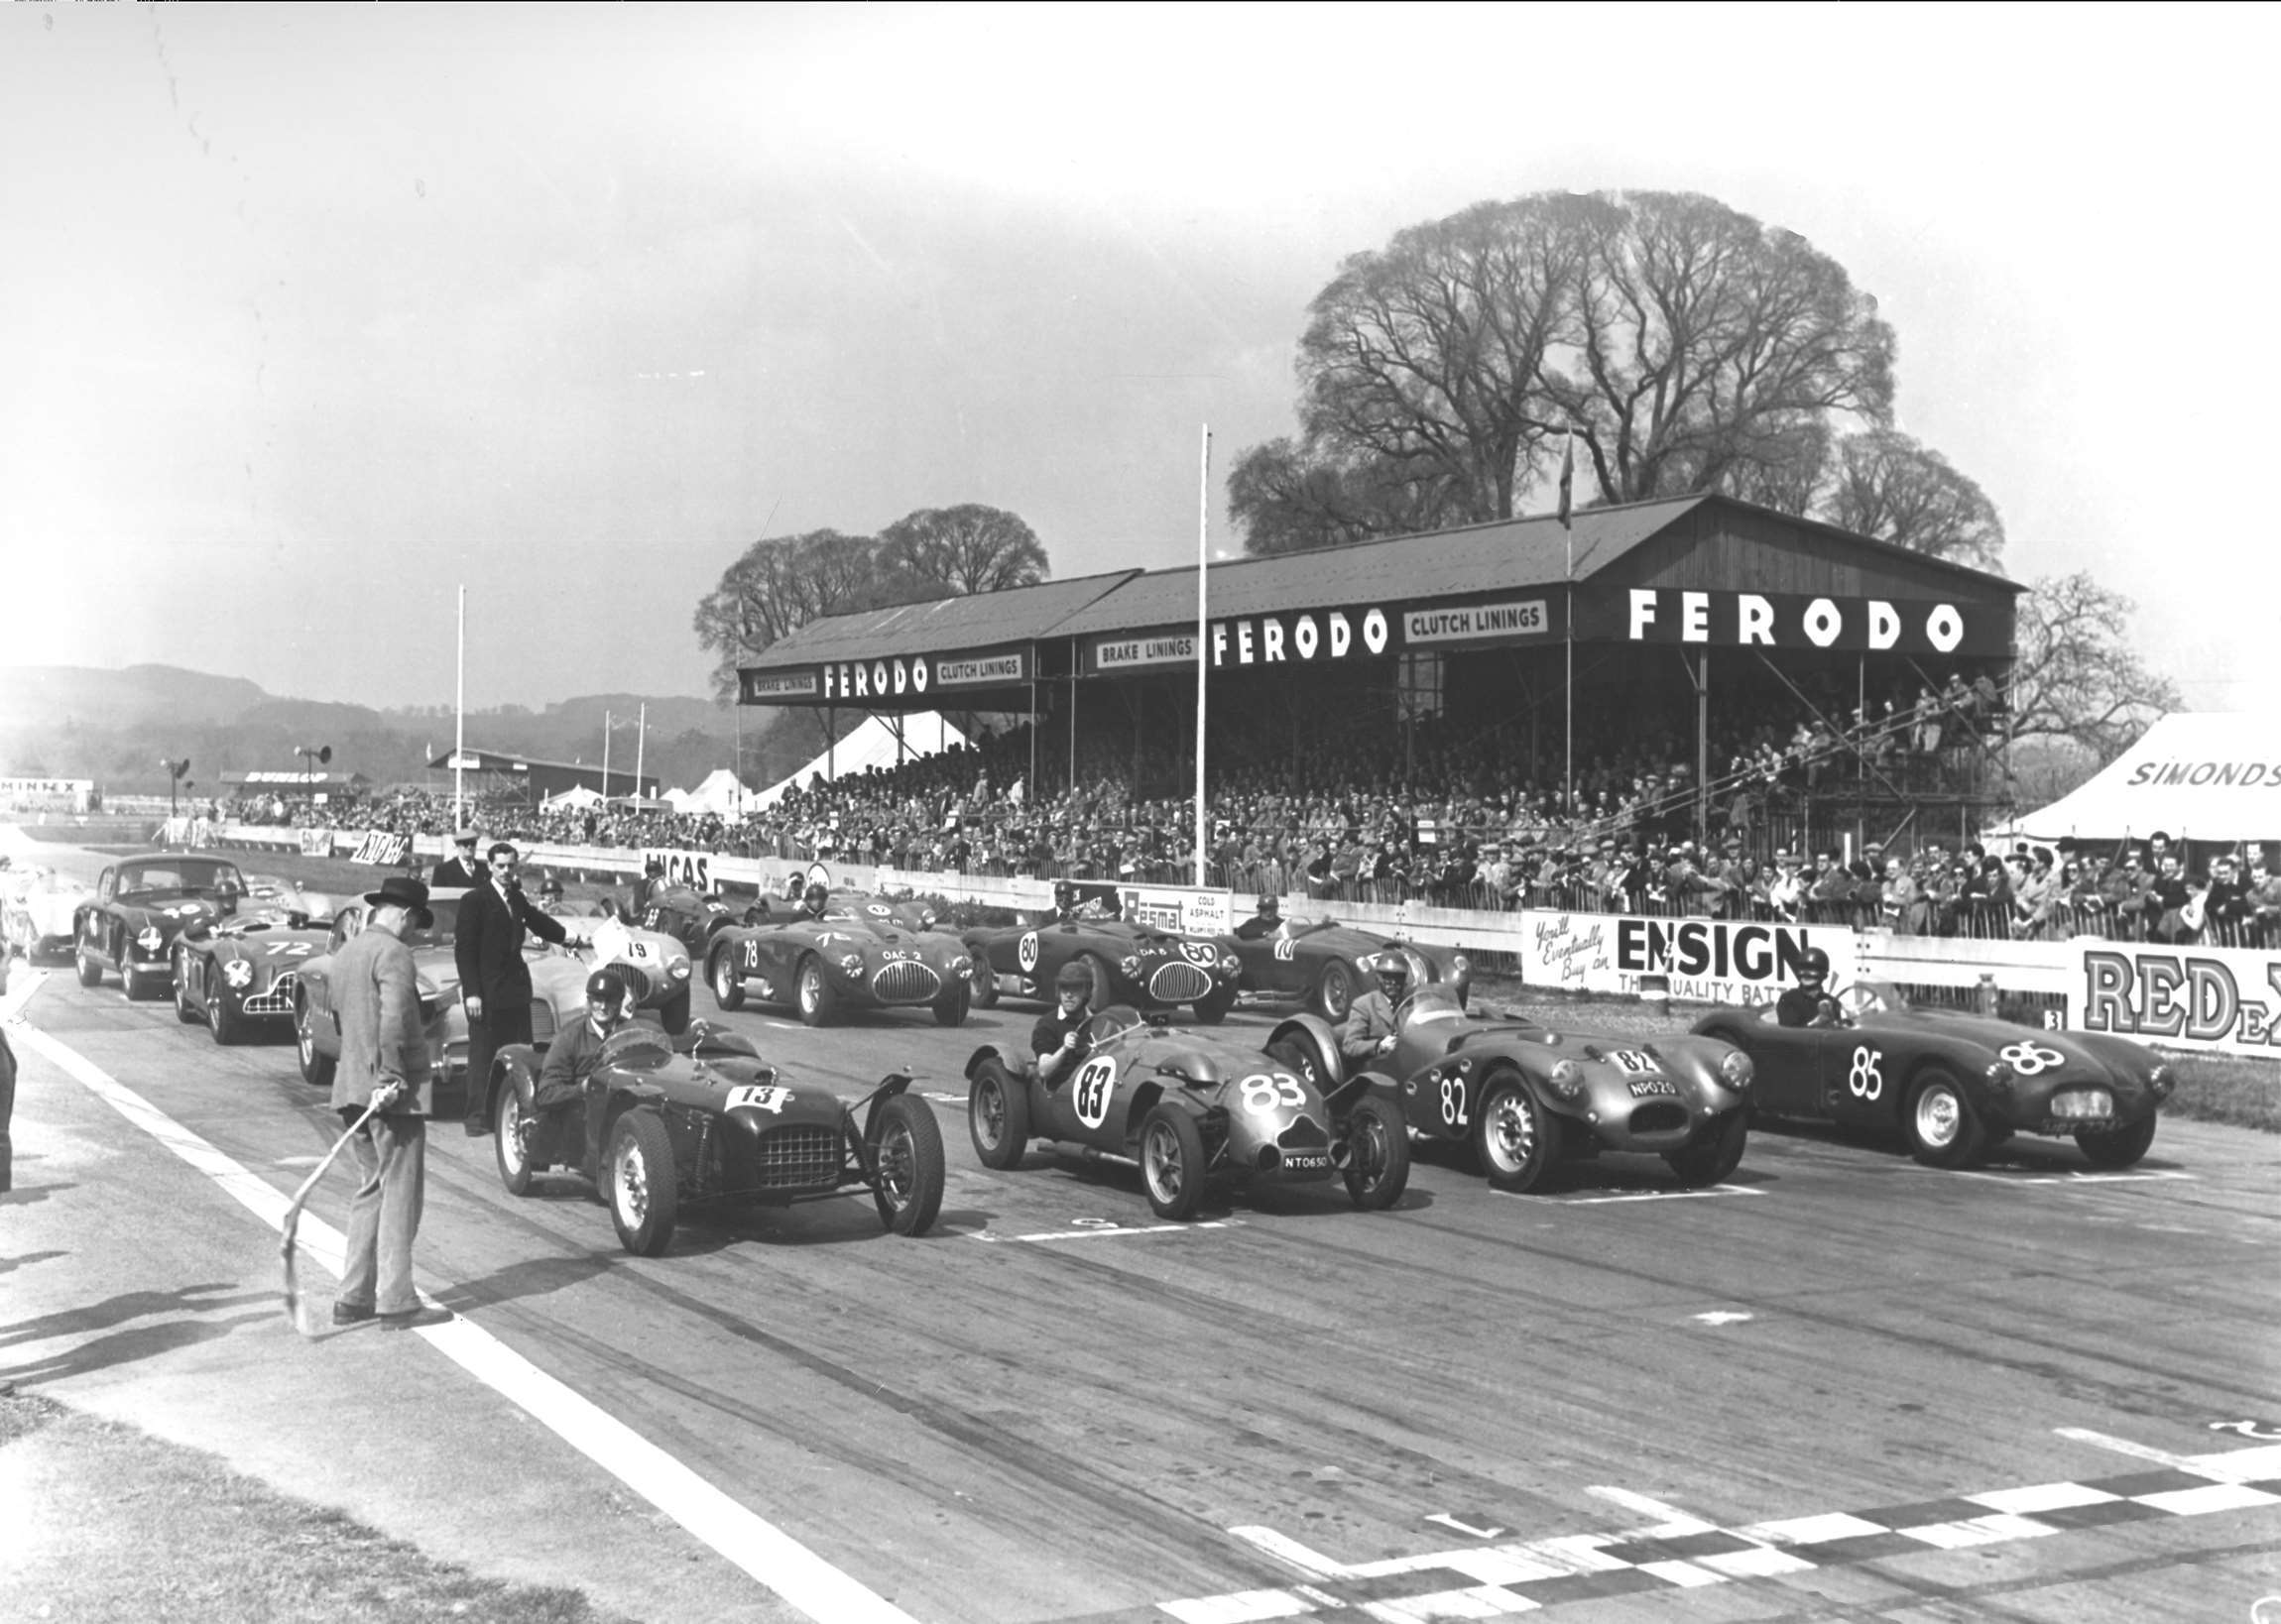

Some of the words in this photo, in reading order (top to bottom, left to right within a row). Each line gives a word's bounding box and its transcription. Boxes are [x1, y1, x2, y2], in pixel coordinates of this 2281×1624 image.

[1411, 614, 1470, 636] CLUTCH
[1476, 607, 1540, 631] LININGS
[1628, 588, 1964, 652] FERODO
[1212, 608, 1388, 666] FERODO
[1102, 643, 1139, 663] BRAKE
[1146, 639, 1192, 659] LININGS
[823, 656, 928, 699] FERODO
[940, 662, 978, 680] CLUTCH
[981, 658, 1018, 677] LININGS
[2126, 761, 2281, 787] SIMONDS
[646, 853, 708, 892] UCAS
[1189, 908, 1225, 920] ASPHALT
[1198, 895, 1216, 906] COLD
[266, 941, 313, 956] 72
[744, 942, 759, 968] 78
[882, 950, 906, 961] OAC
[1020, 938, 1036, 964] 80
[1184, 944, 1216, 964] 80
[1542, 923, 1604, 966] Eventually
[1618, 919, 1809, 982] ENSIGN
[1561, 957, 1587, 984] Buy
[1592, 956, 1610, 970] an
[1668, 978, 1734, 1002] UALITY
[1617, 1051, 1655, 1072] 82
[1999, 1040, 2065, 1075] 85
[1850, 1046, 1882, 1101] 85
[741, 1087, 775, 1105] 13
[1077, 1064, 1113, 1120] 83
[1240, 1072, 1307, 1116] 83
[1441, 1077, 1469, 1125] 82
